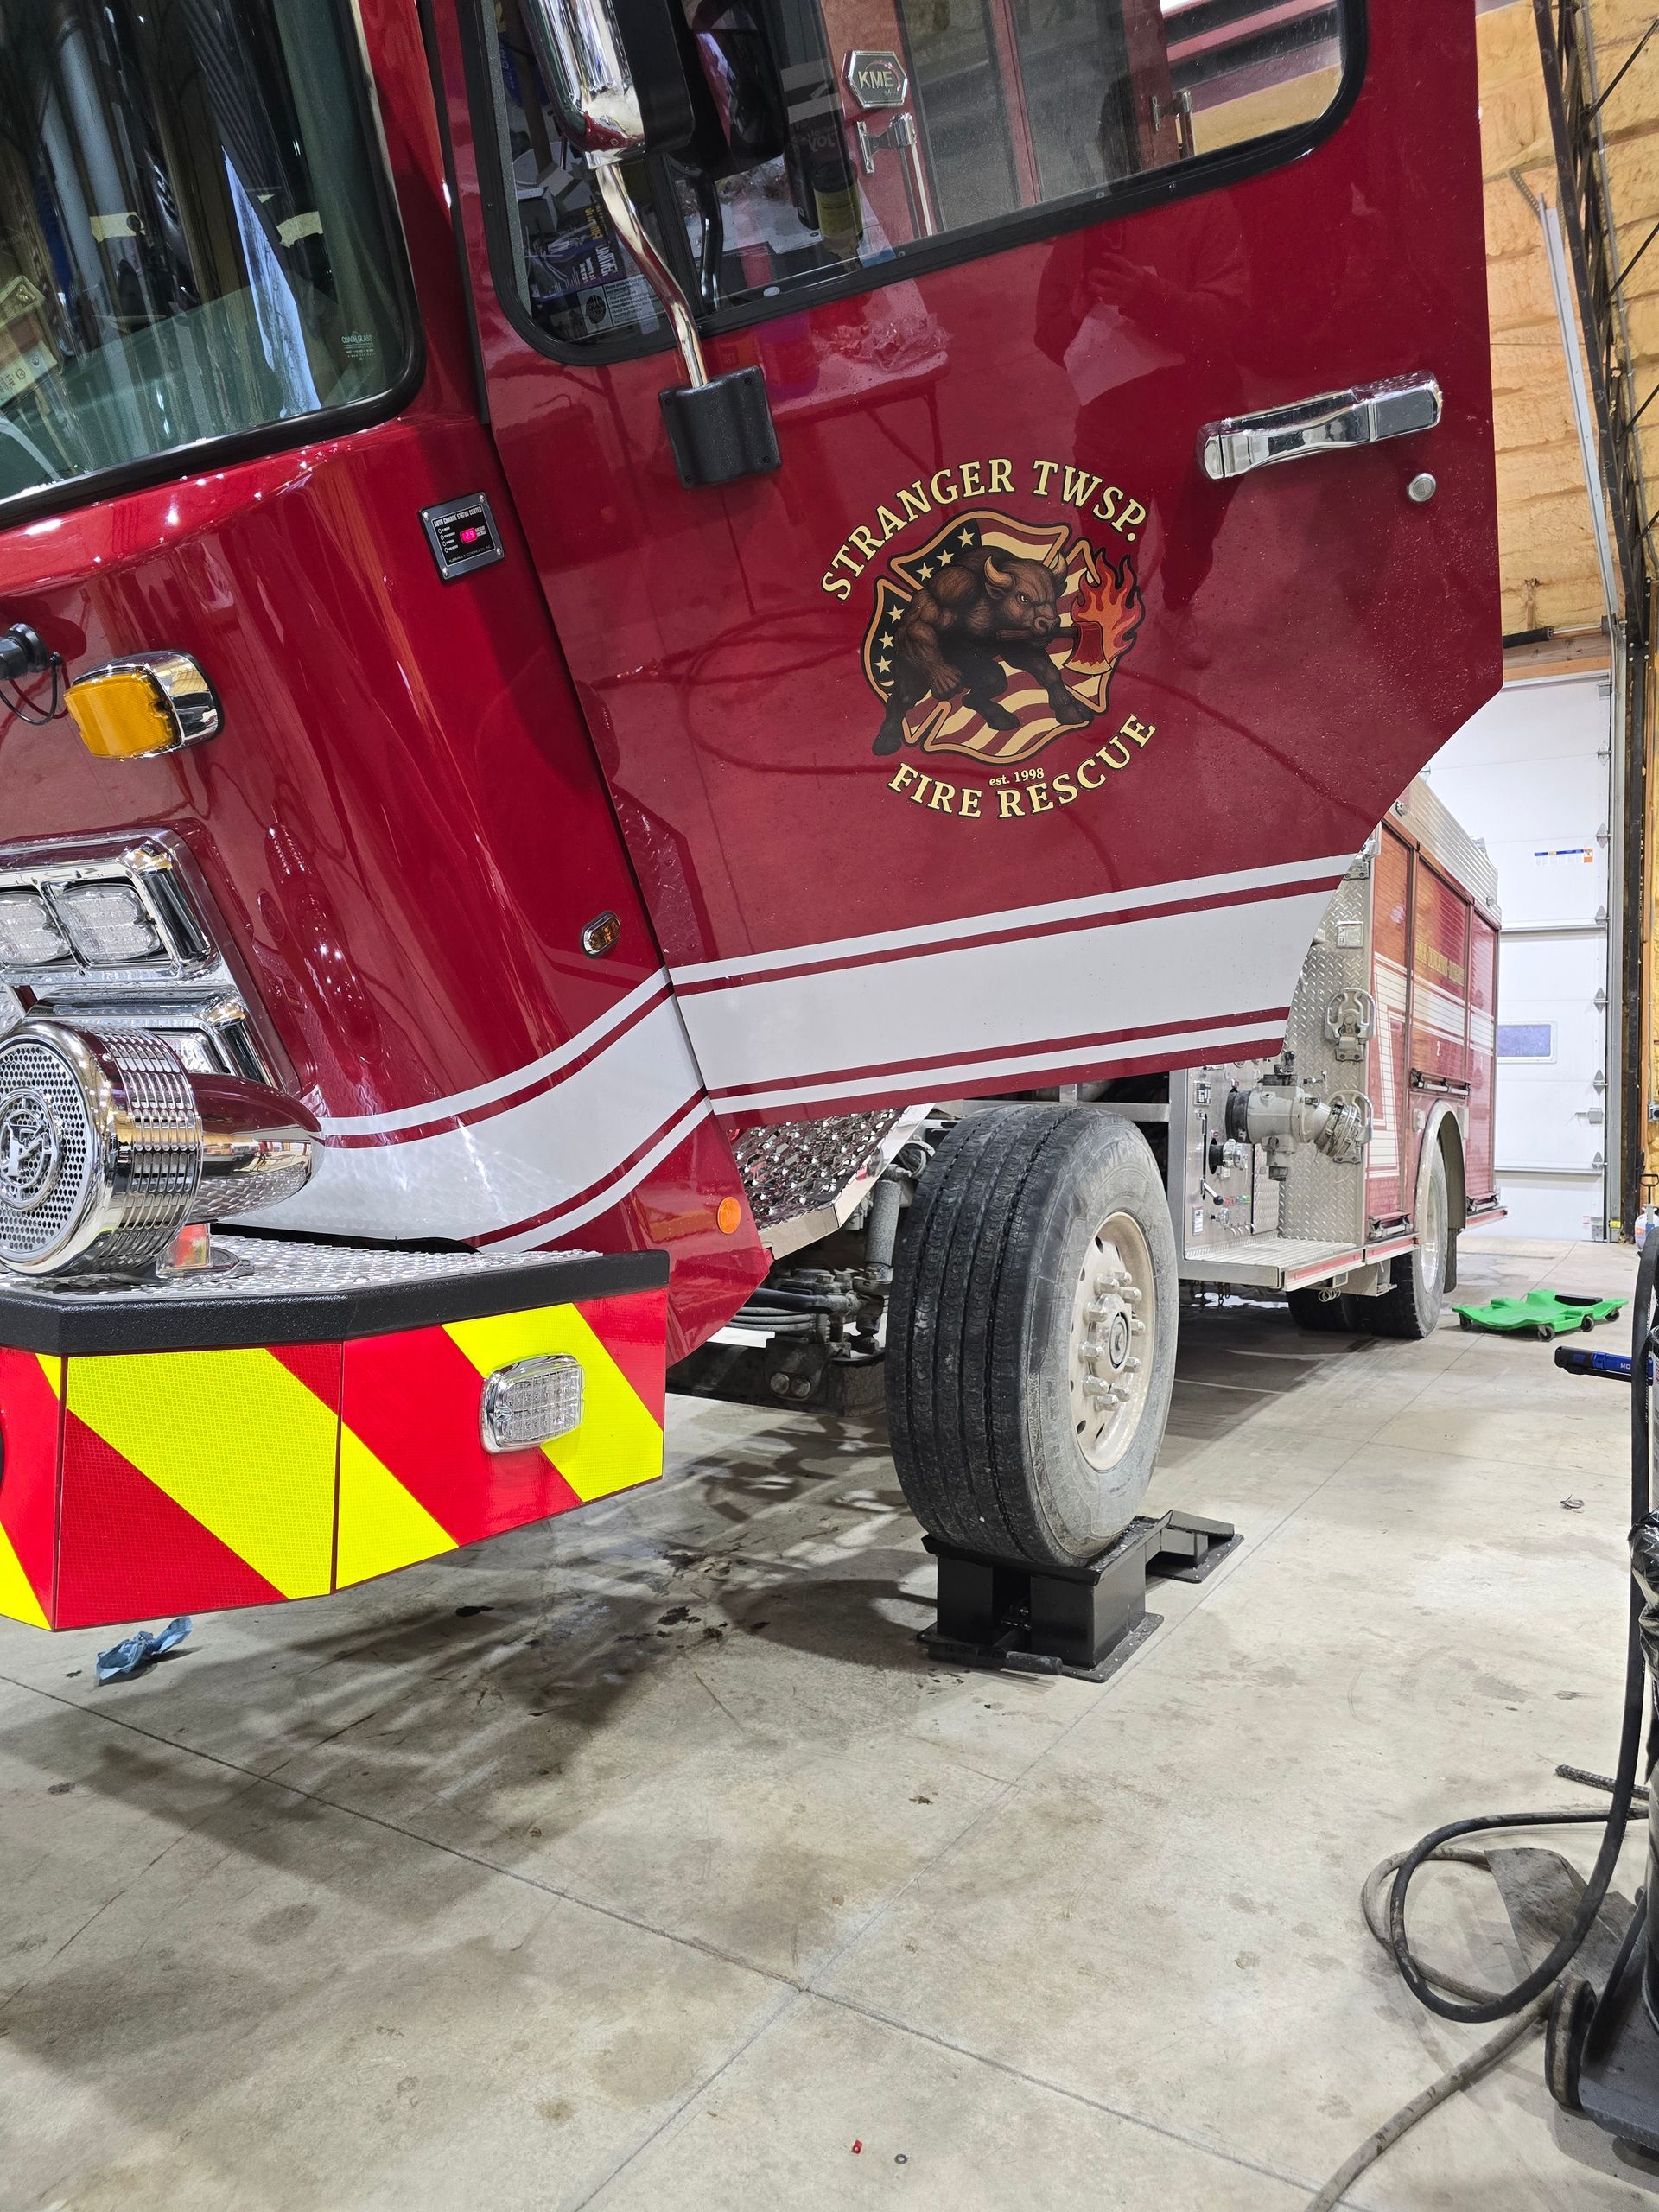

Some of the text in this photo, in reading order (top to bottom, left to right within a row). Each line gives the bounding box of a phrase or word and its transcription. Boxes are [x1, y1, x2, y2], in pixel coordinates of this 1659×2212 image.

[858, 70, 894, 89] KME
[822, 457, 1148, 601] STRANGER TWSP.
[887, 715, 1157, 818] FIRE RESCUE
[988, 766, 1046, 787] est. 1998
